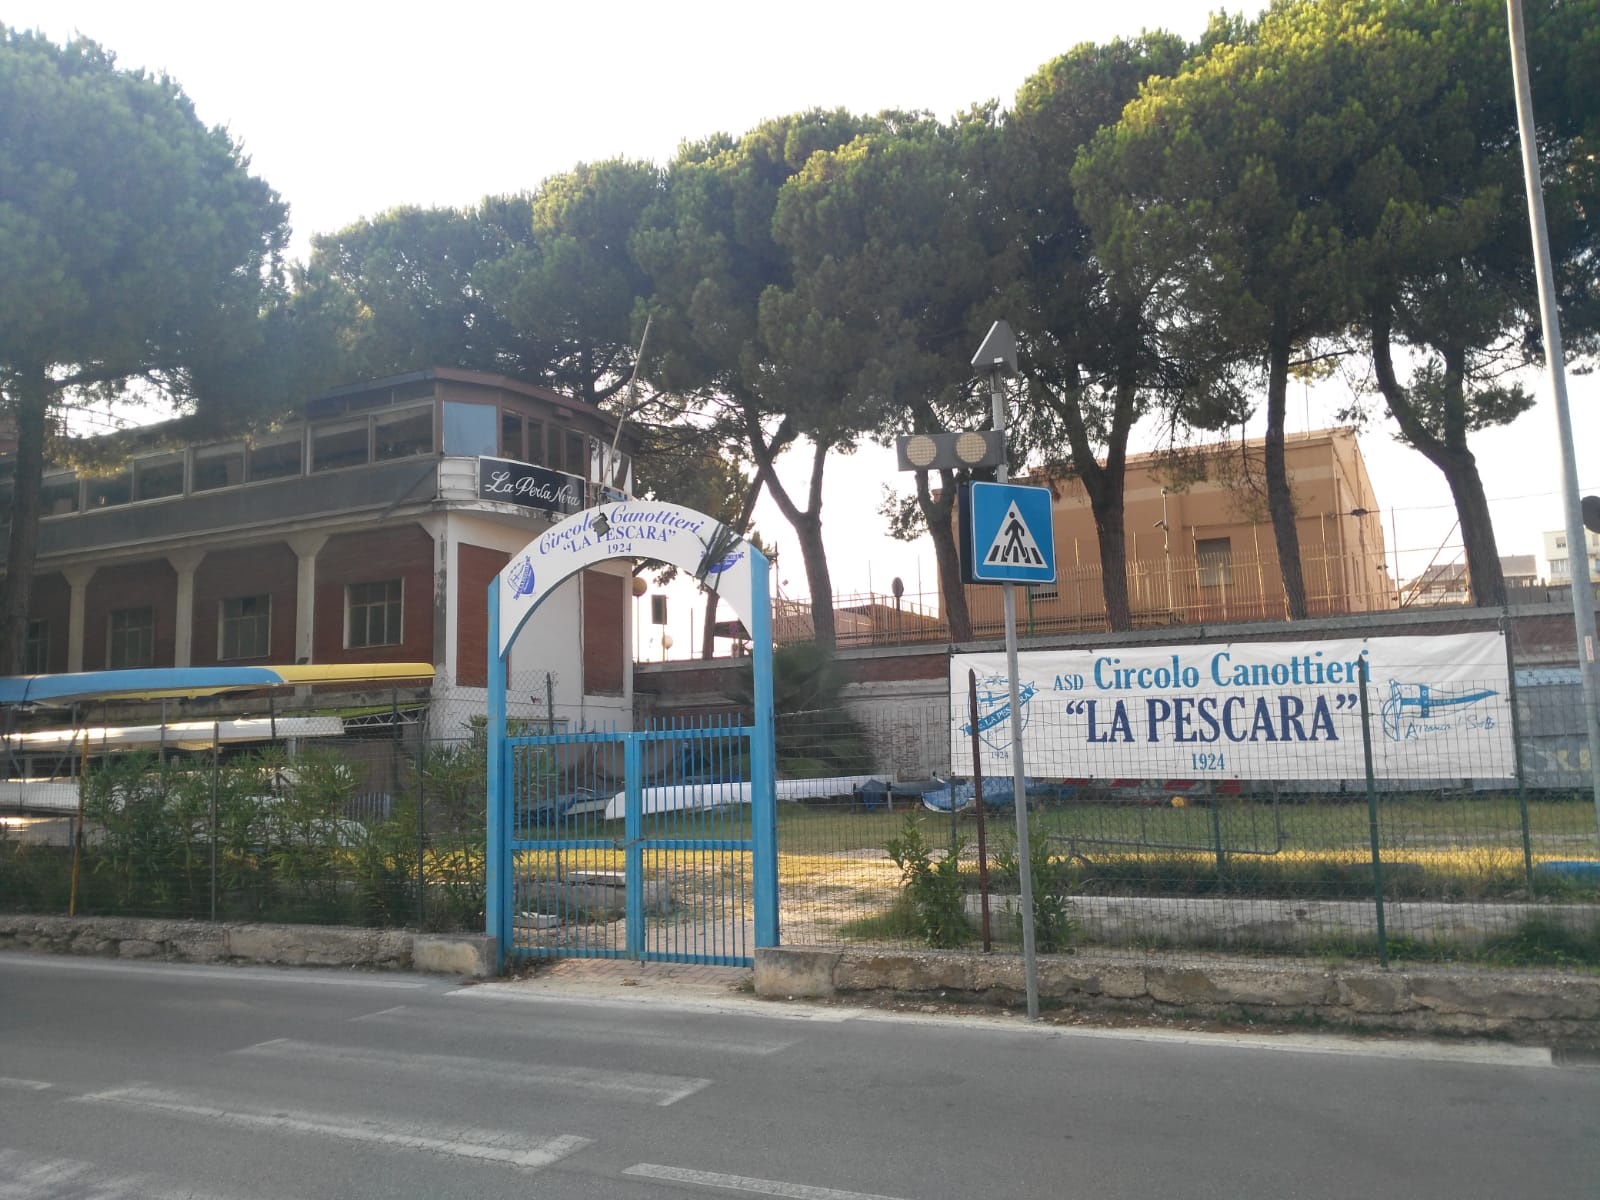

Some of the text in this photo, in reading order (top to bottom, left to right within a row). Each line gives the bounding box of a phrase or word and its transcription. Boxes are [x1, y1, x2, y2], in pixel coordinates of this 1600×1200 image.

[485, 471, 514, 493] La
[515, 476, 552, 500] Perla
[610, 504, 705, 534] Canottieri
[607, 542, 632, 554] 1924
[1053, 649, 1371, 691] ASD Circolo Canottieri
[1191, 753, 1225, 770] 1924
